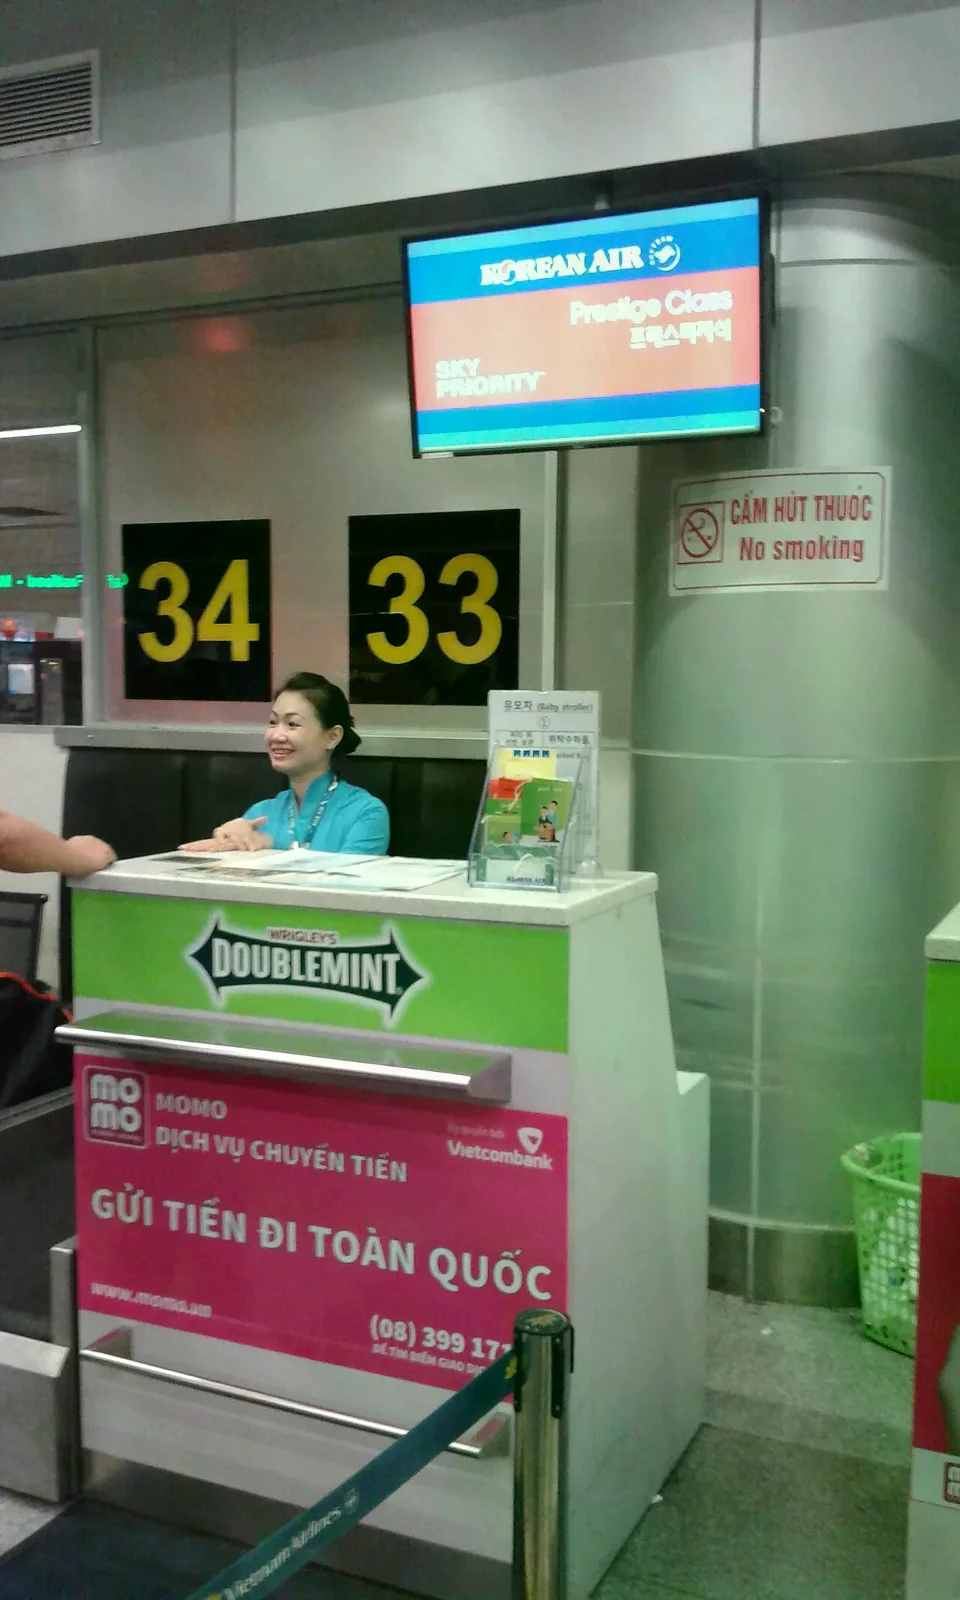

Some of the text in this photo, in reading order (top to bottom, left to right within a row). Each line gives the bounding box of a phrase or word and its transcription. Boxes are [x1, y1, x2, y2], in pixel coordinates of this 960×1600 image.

[480, 252, 587, 286] KOREAN
[589, 245, 645, 274] AIR
[570, 289, 734, 326] Prestige Class
[435, 357, 482, 380] SKY
[436, 371, 542, 398] PRIORITY
[739, 535, 865, 563] No smoking
[138, 558, 260, 664] 34
[366, 553, 502, 665] 33
[504, 699, 533, 712] 유모차
[269, 928, 338, 945] WRIGLEY'S
[211, 937, 401, 996] DOUBLEMINT
[155, 1092, 228, 1120] MOMO
[155, 1126, 210, 1154] DỊCH
[213, 1134, 245, 1163] VỤ
[446, 1138, 553, 1170] Vietcombank
[91, 1182, 154, 1227] GỬI
[256, 1215, 298, 1254] ĐI
[307, 1225, 416, 1276] TOÀN
[428, 1247, 553, 1301] QUỐC
[369, 1313, 416, 1349] (08)
[420, 1326, 466, 1354] 399
[224, 1506, 342, 1600] Vietnam Airlines
